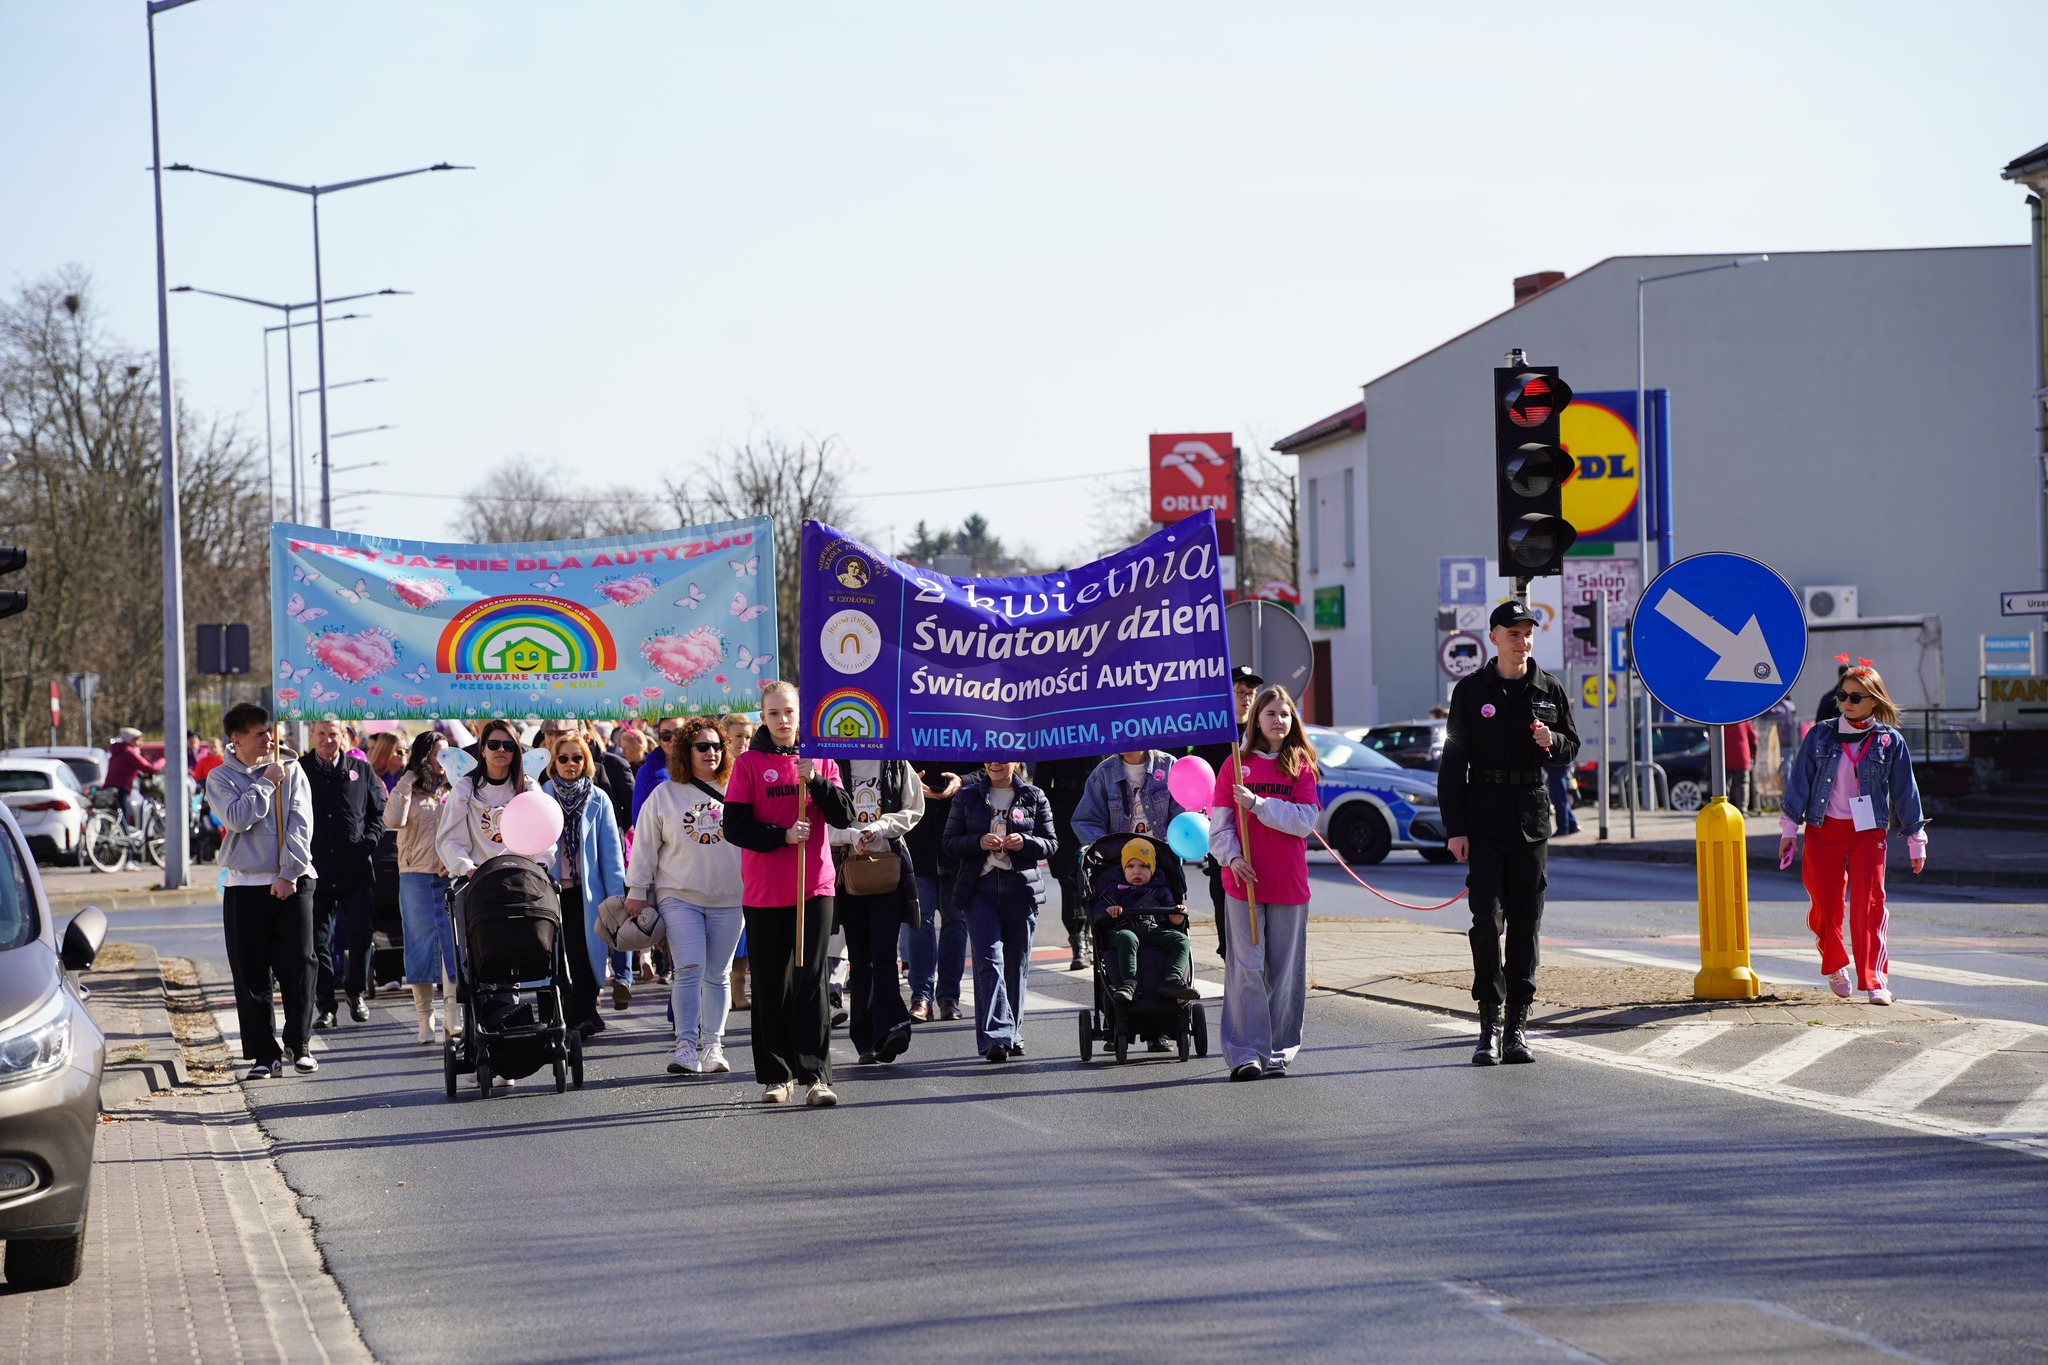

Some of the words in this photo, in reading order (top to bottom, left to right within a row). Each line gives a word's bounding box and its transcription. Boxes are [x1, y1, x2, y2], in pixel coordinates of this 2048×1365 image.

[1161, 494, 1227, 512] ORLEN
[289, 539, 509, 572] PRZYJAŹNIE
[515, 556, 584, 572] DLA
[589, 532, 753, 568] AUTYZMU
[914, 577, 945, 603] 2
[962, 535, 1217, 619] kwietnia
[1450, 562, 1477, 600] P
[1577, 573, 1625, 588] Salon
[2027, 599, 2048, 610] Urzą
[912, 614, 1111, 660] Światowy
[1117, 594, 1220, 641] dzień
[450, 682, 547, 691] PRZEDSZKOLE
[569, 681, 605, 689] KOLE
[455, 673, 529, 681] PRYWATNE
[534, 671, 599, 682] TĘCZOWE
[909, 665, 1088, 703] Świadomości
[1096, 656, 1225, 691] Autyzmu
[1990, 679, 2048, 702] KAN
[911, 727, 978, 752] WIEM,
[985, 722, 1105, 750] ROZUMIEM,
[1111, 709, 1228, 740] POMAGAM
